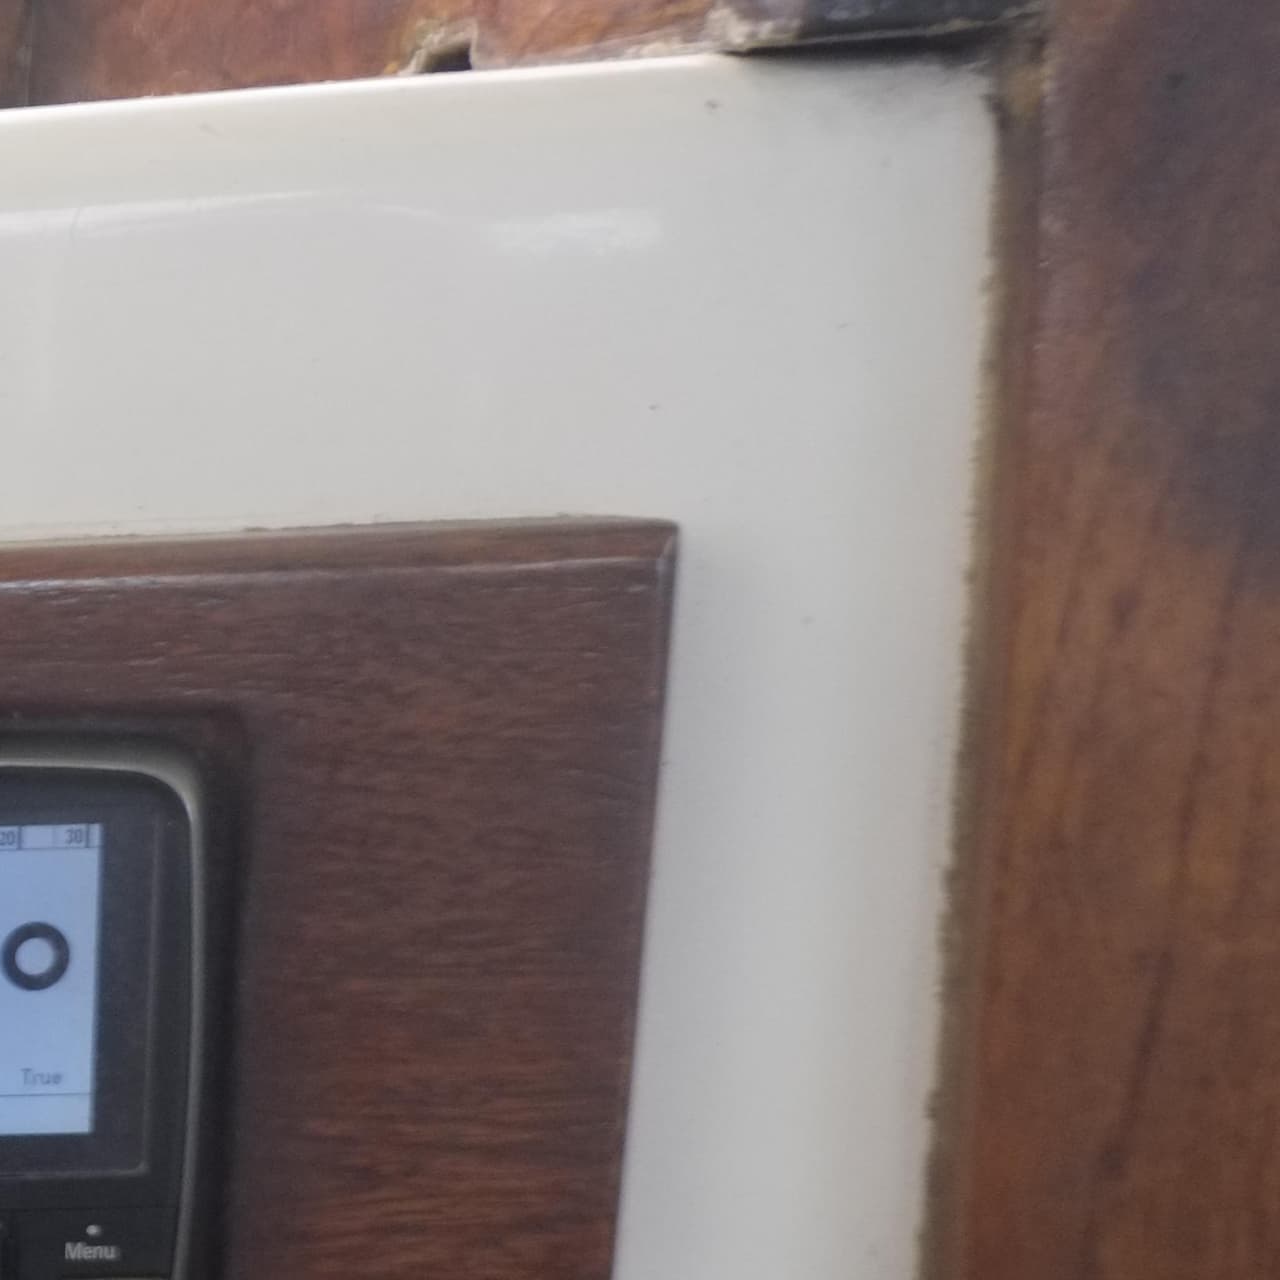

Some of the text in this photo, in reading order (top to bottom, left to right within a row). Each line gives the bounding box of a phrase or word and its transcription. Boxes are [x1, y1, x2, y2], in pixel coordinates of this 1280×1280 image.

[64, 827, 85, 846] 30
[20, 1068, 62, 1086] True
[65, 1242, 117, 1260] Menu
